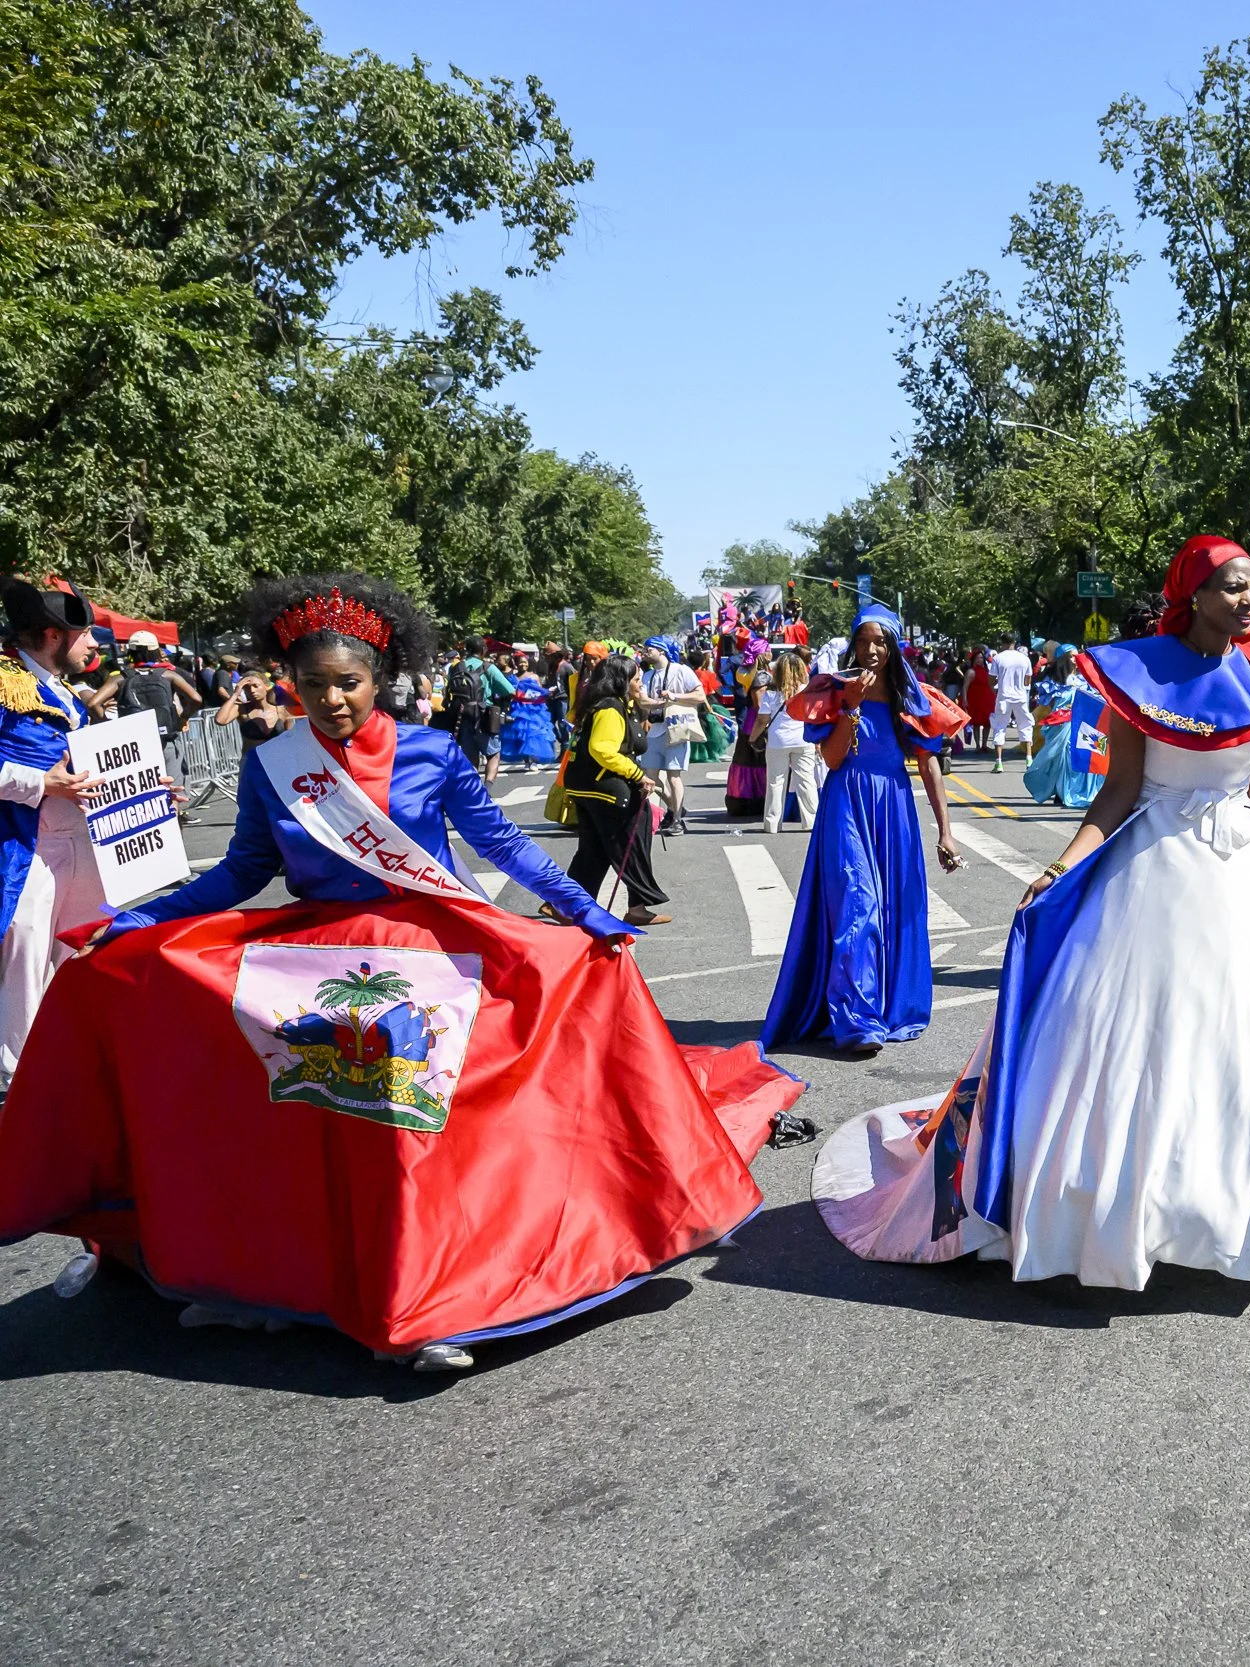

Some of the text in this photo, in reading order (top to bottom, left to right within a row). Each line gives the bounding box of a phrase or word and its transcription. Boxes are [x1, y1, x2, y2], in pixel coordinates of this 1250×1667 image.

[95, 741, 141, 774] LABOR
[92, 793, 172, 842] IMMIGRANT
[115, 828, 164, 866] RIGHTS
